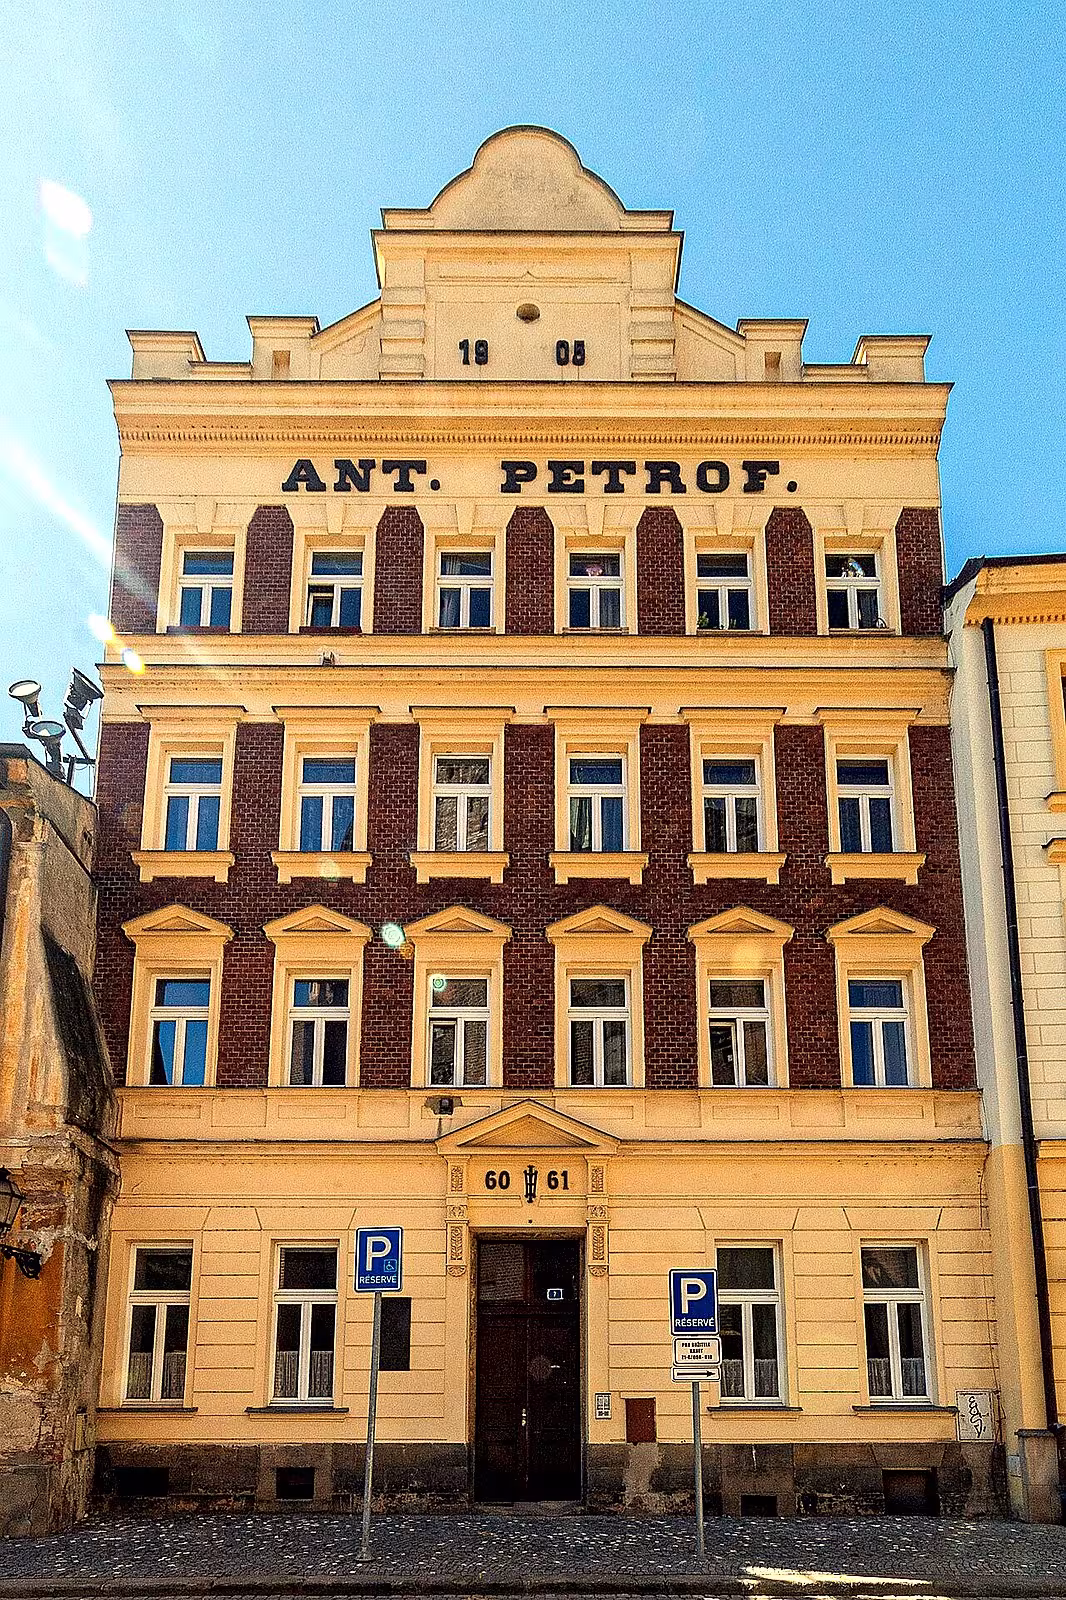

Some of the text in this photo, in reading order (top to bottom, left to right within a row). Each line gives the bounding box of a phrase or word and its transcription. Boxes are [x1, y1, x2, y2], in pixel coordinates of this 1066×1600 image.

[458, 339, 586, 366] 19 05
[282, 459, 798, 494] ANT. PETROF.
[485, 1170, 569, 1190] 60 61
[366, 1236, 392, 1271] P
[680, 1277, 707, 1314] P
[675, 1317, 715, 1327] RÉSERVÉ
